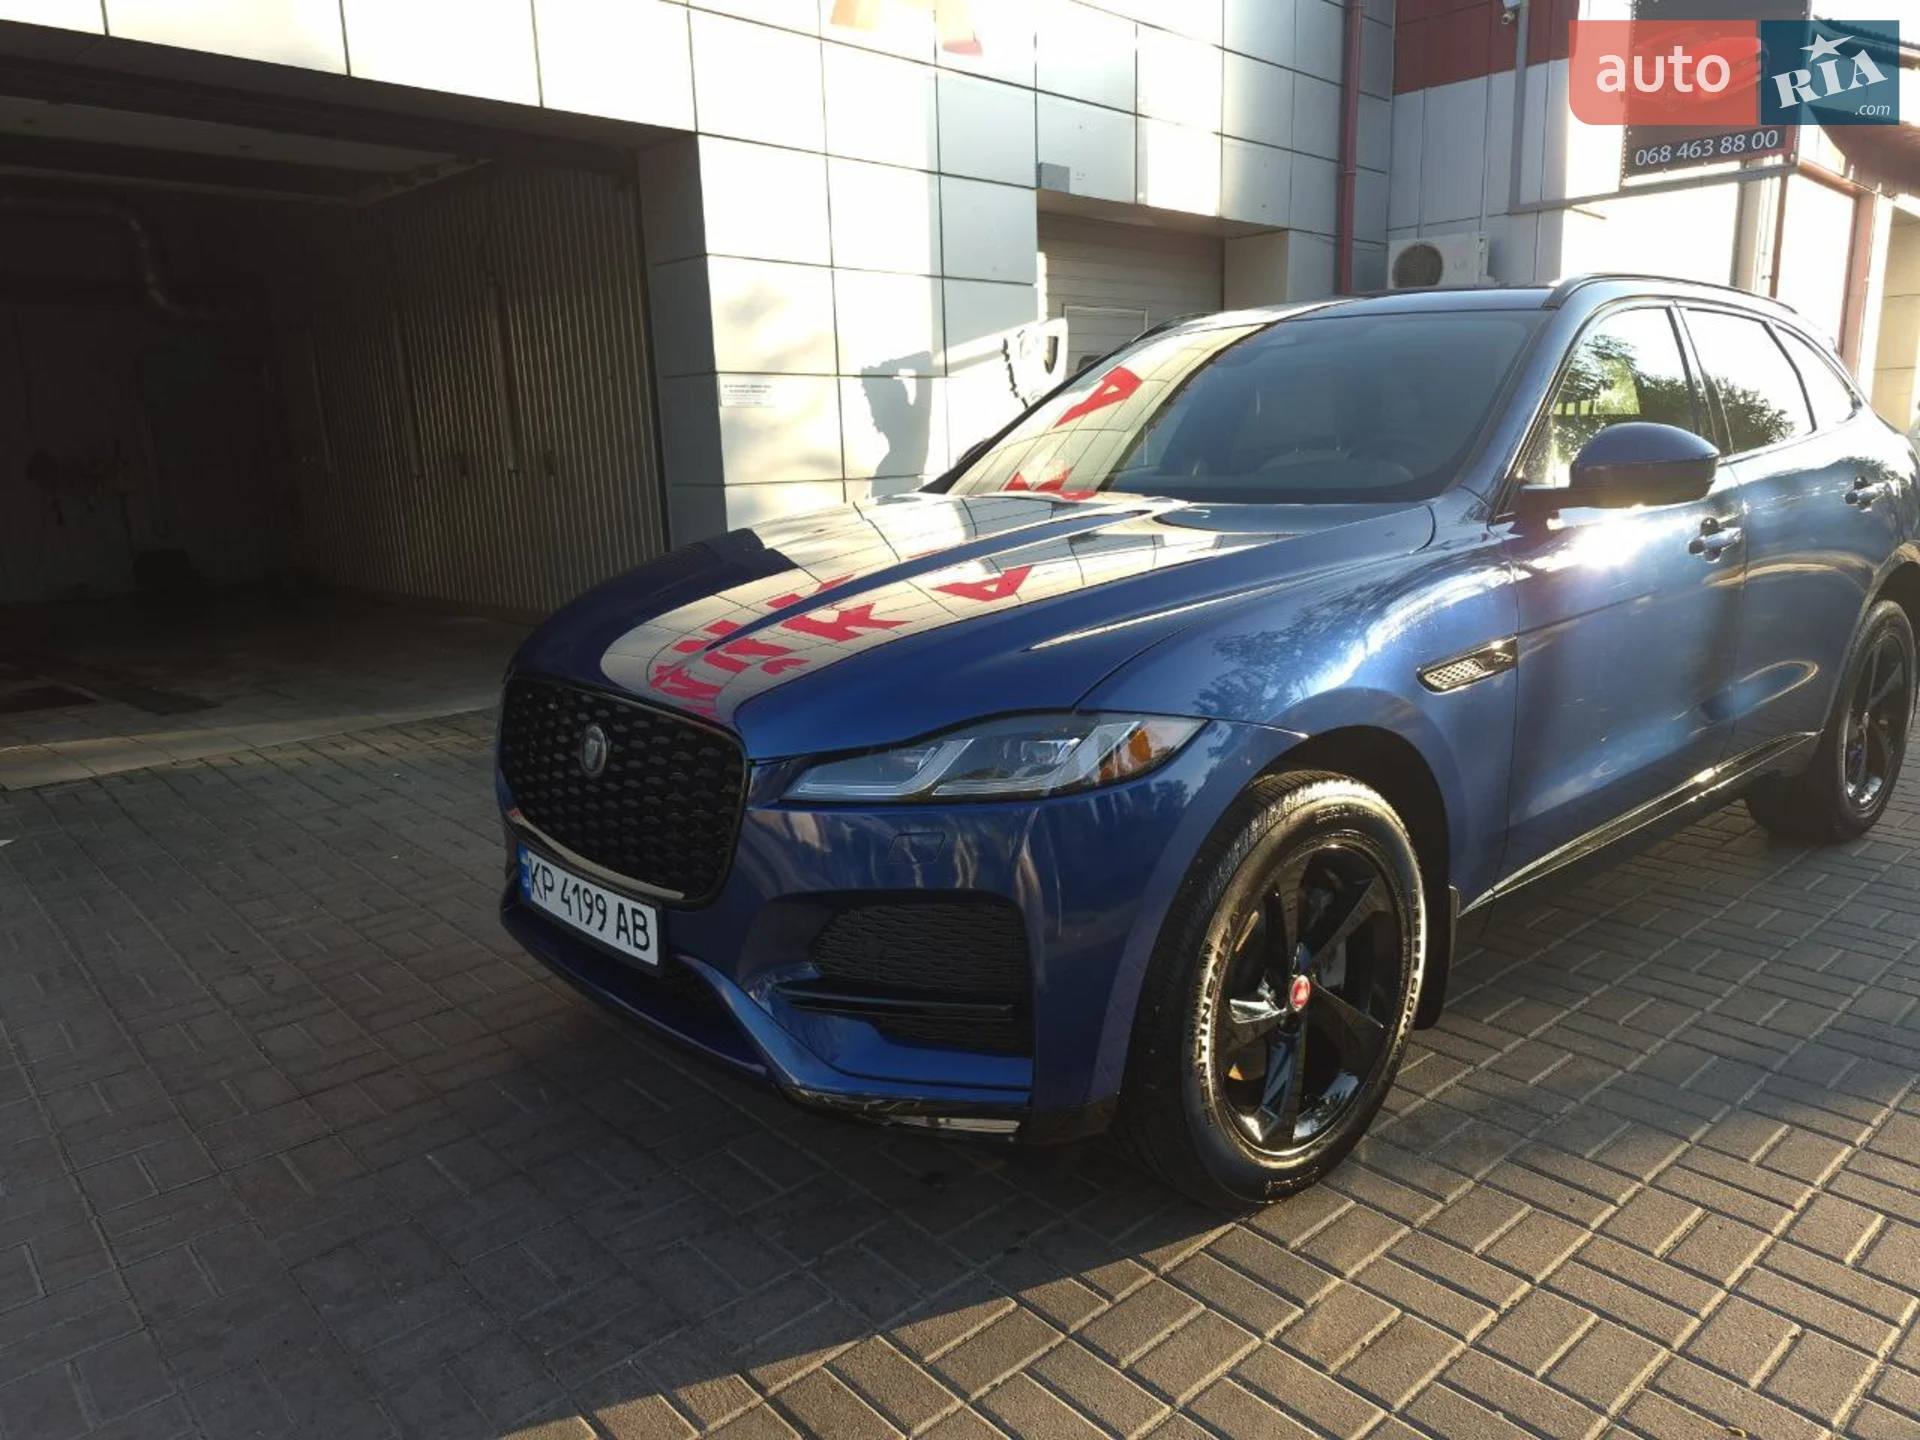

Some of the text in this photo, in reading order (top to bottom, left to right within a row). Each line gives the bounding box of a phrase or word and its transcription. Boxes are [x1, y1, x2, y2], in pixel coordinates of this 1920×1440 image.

[1635, 129, 1778, 167] 068 463 88 00
[528, 857, 650, 951] KP 4199 AB
